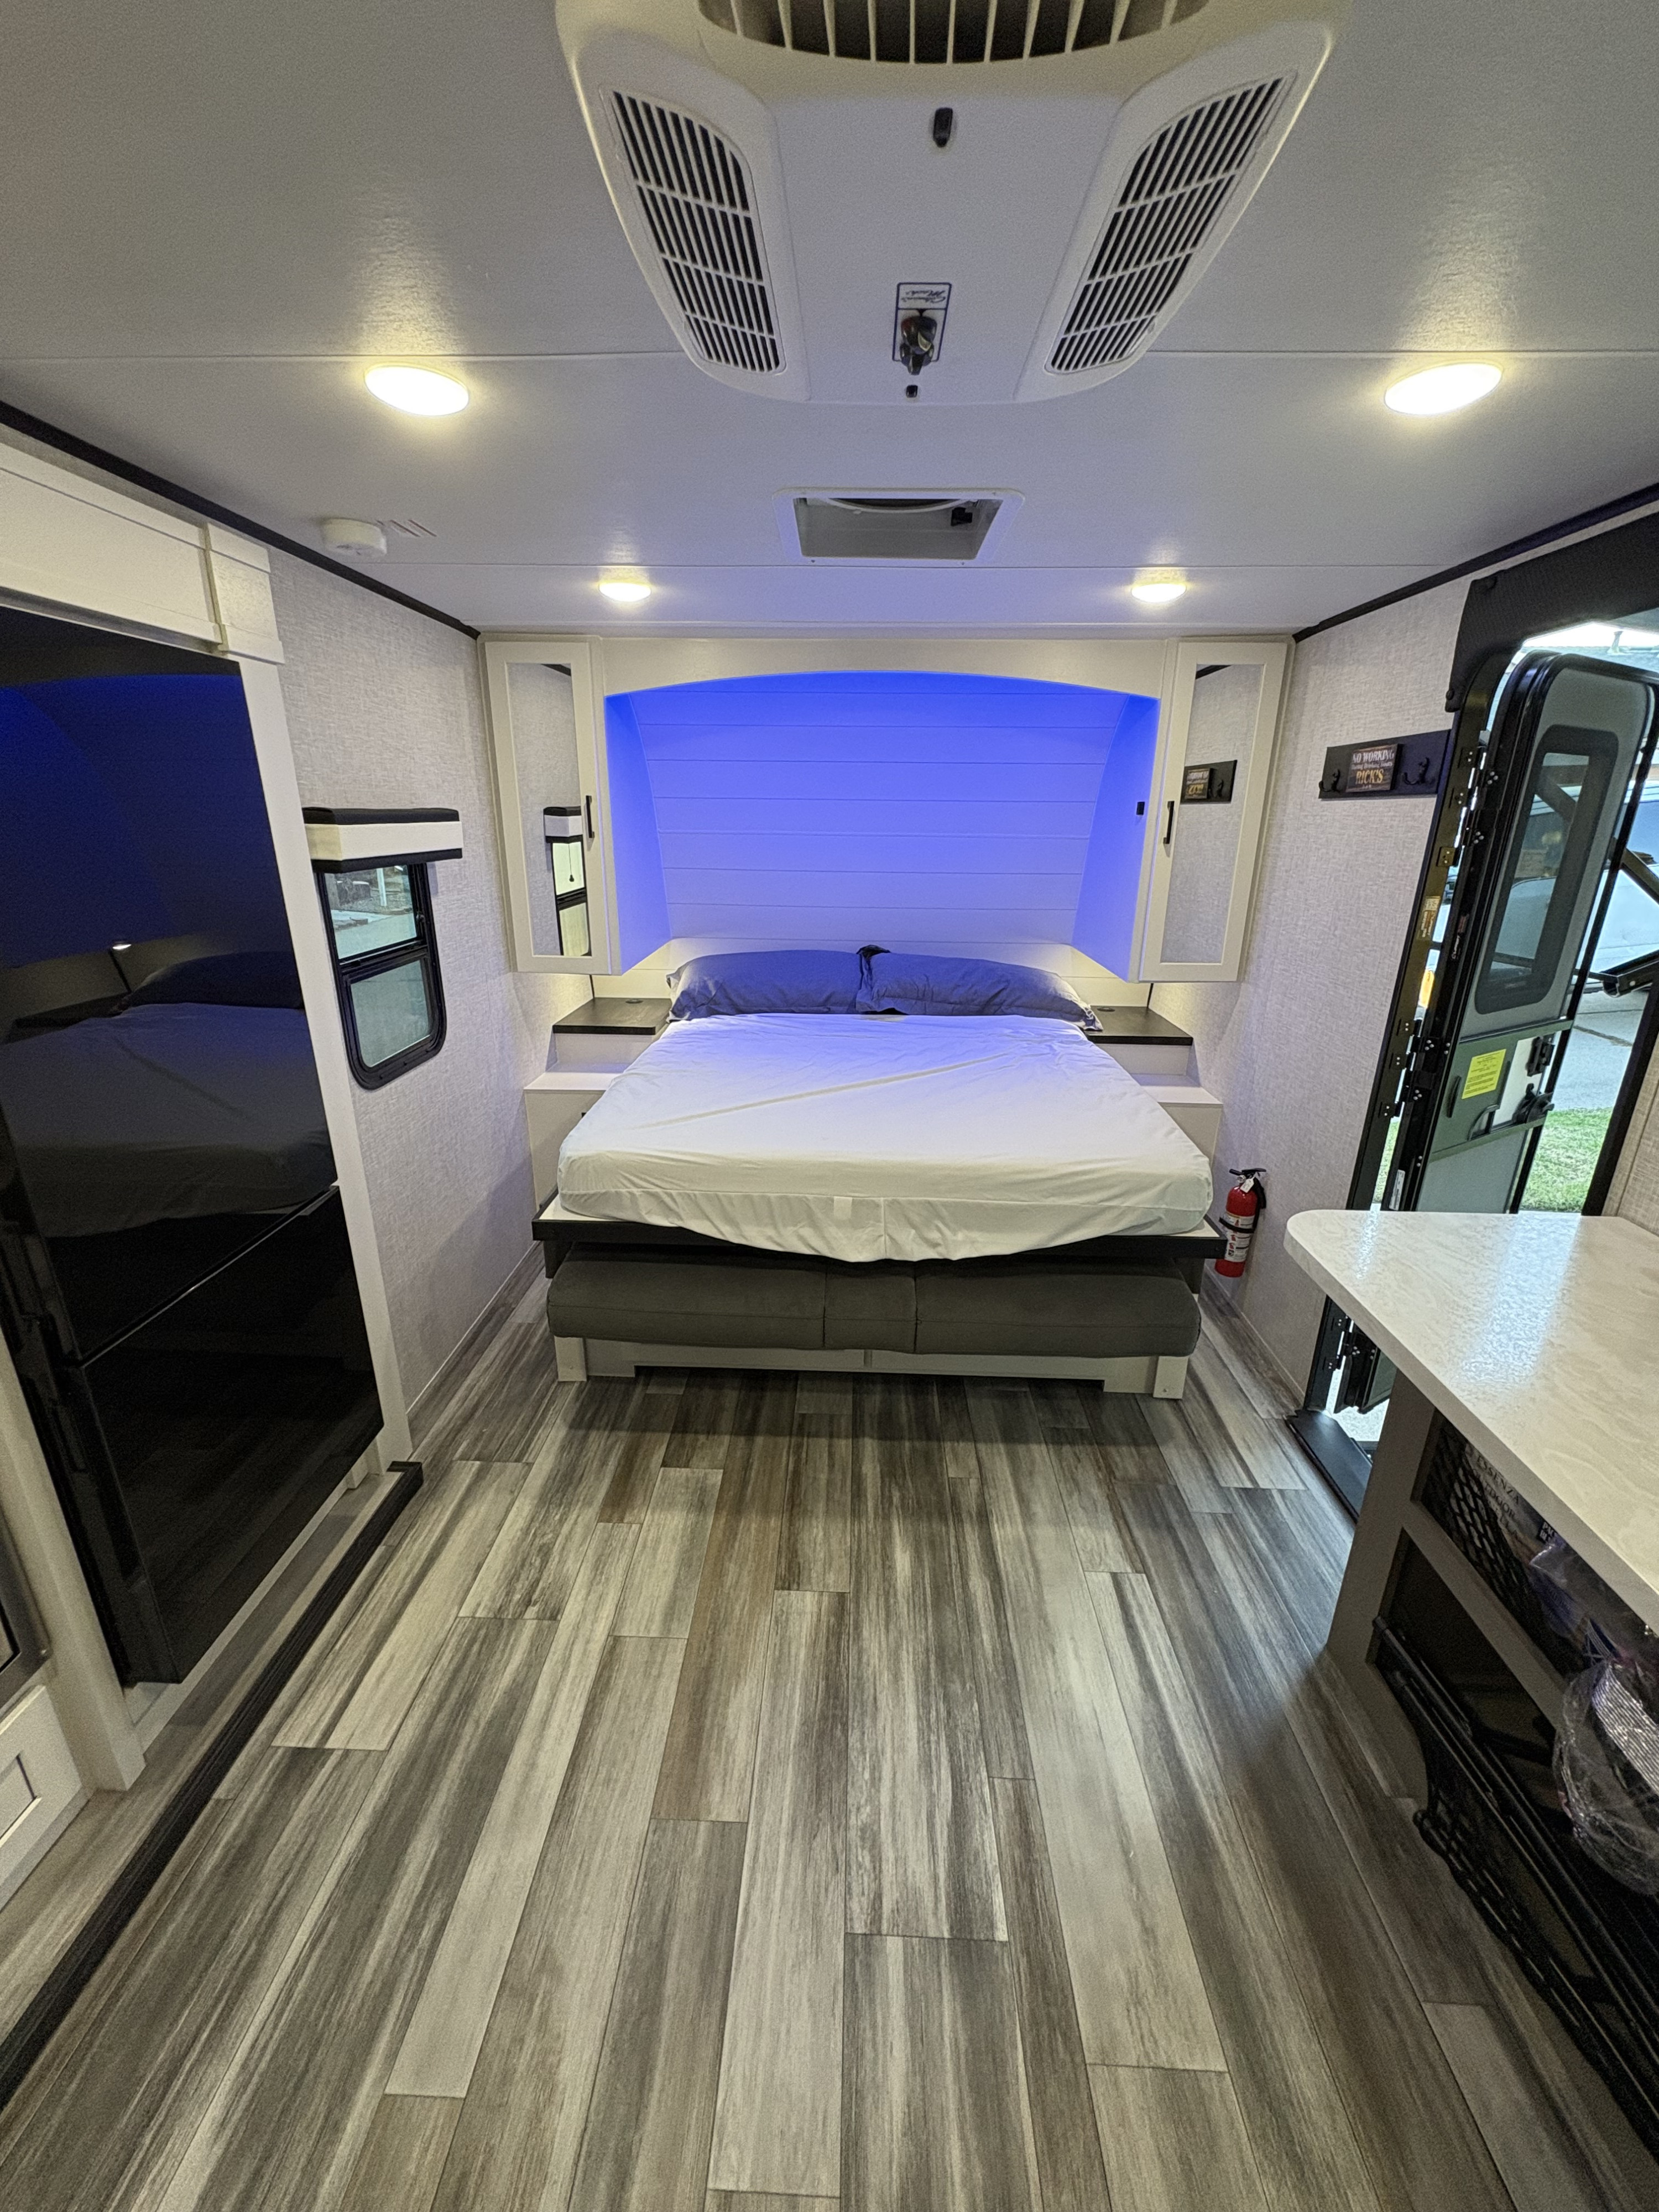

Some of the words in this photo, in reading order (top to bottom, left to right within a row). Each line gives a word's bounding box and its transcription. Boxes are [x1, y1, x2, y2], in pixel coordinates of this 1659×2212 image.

[1353, 753, 1361, 763] NO
[1363, 750, 1395, 763] WORKING
[1355, 769, 1384, 784] RICK'S
[1477, 1455, 1520, 1505] ESSENZA
